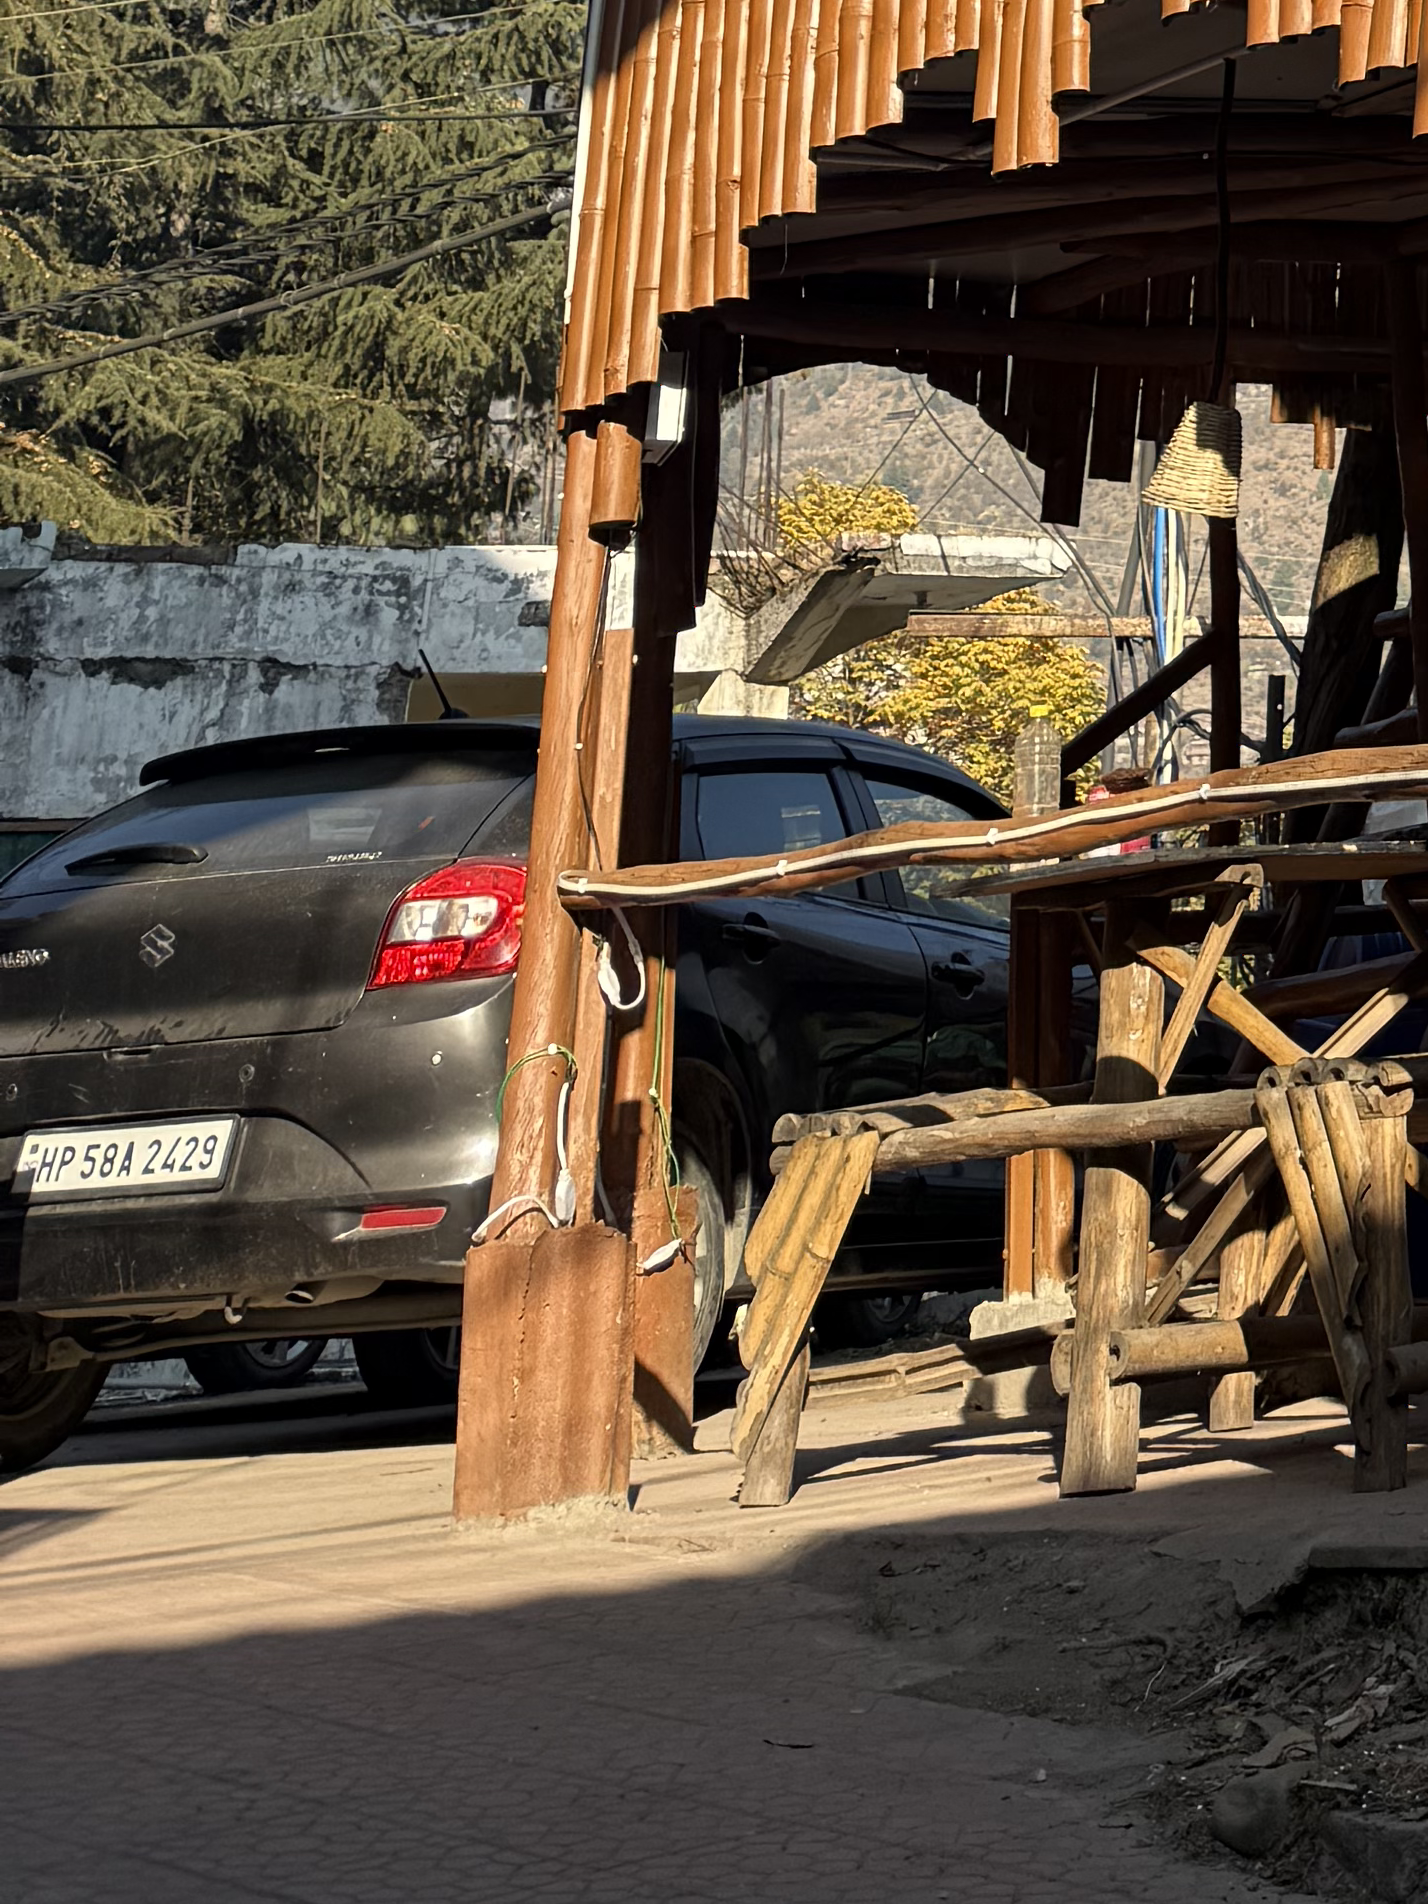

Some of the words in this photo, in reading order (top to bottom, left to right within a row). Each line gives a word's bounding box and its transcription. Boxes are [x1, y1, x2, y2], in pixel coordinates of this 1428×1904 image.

[35, 1146, 76, 1182] HP
[80, 1141, 135, 1179] 58A
[141, 1134, 218, 1175] 2429
